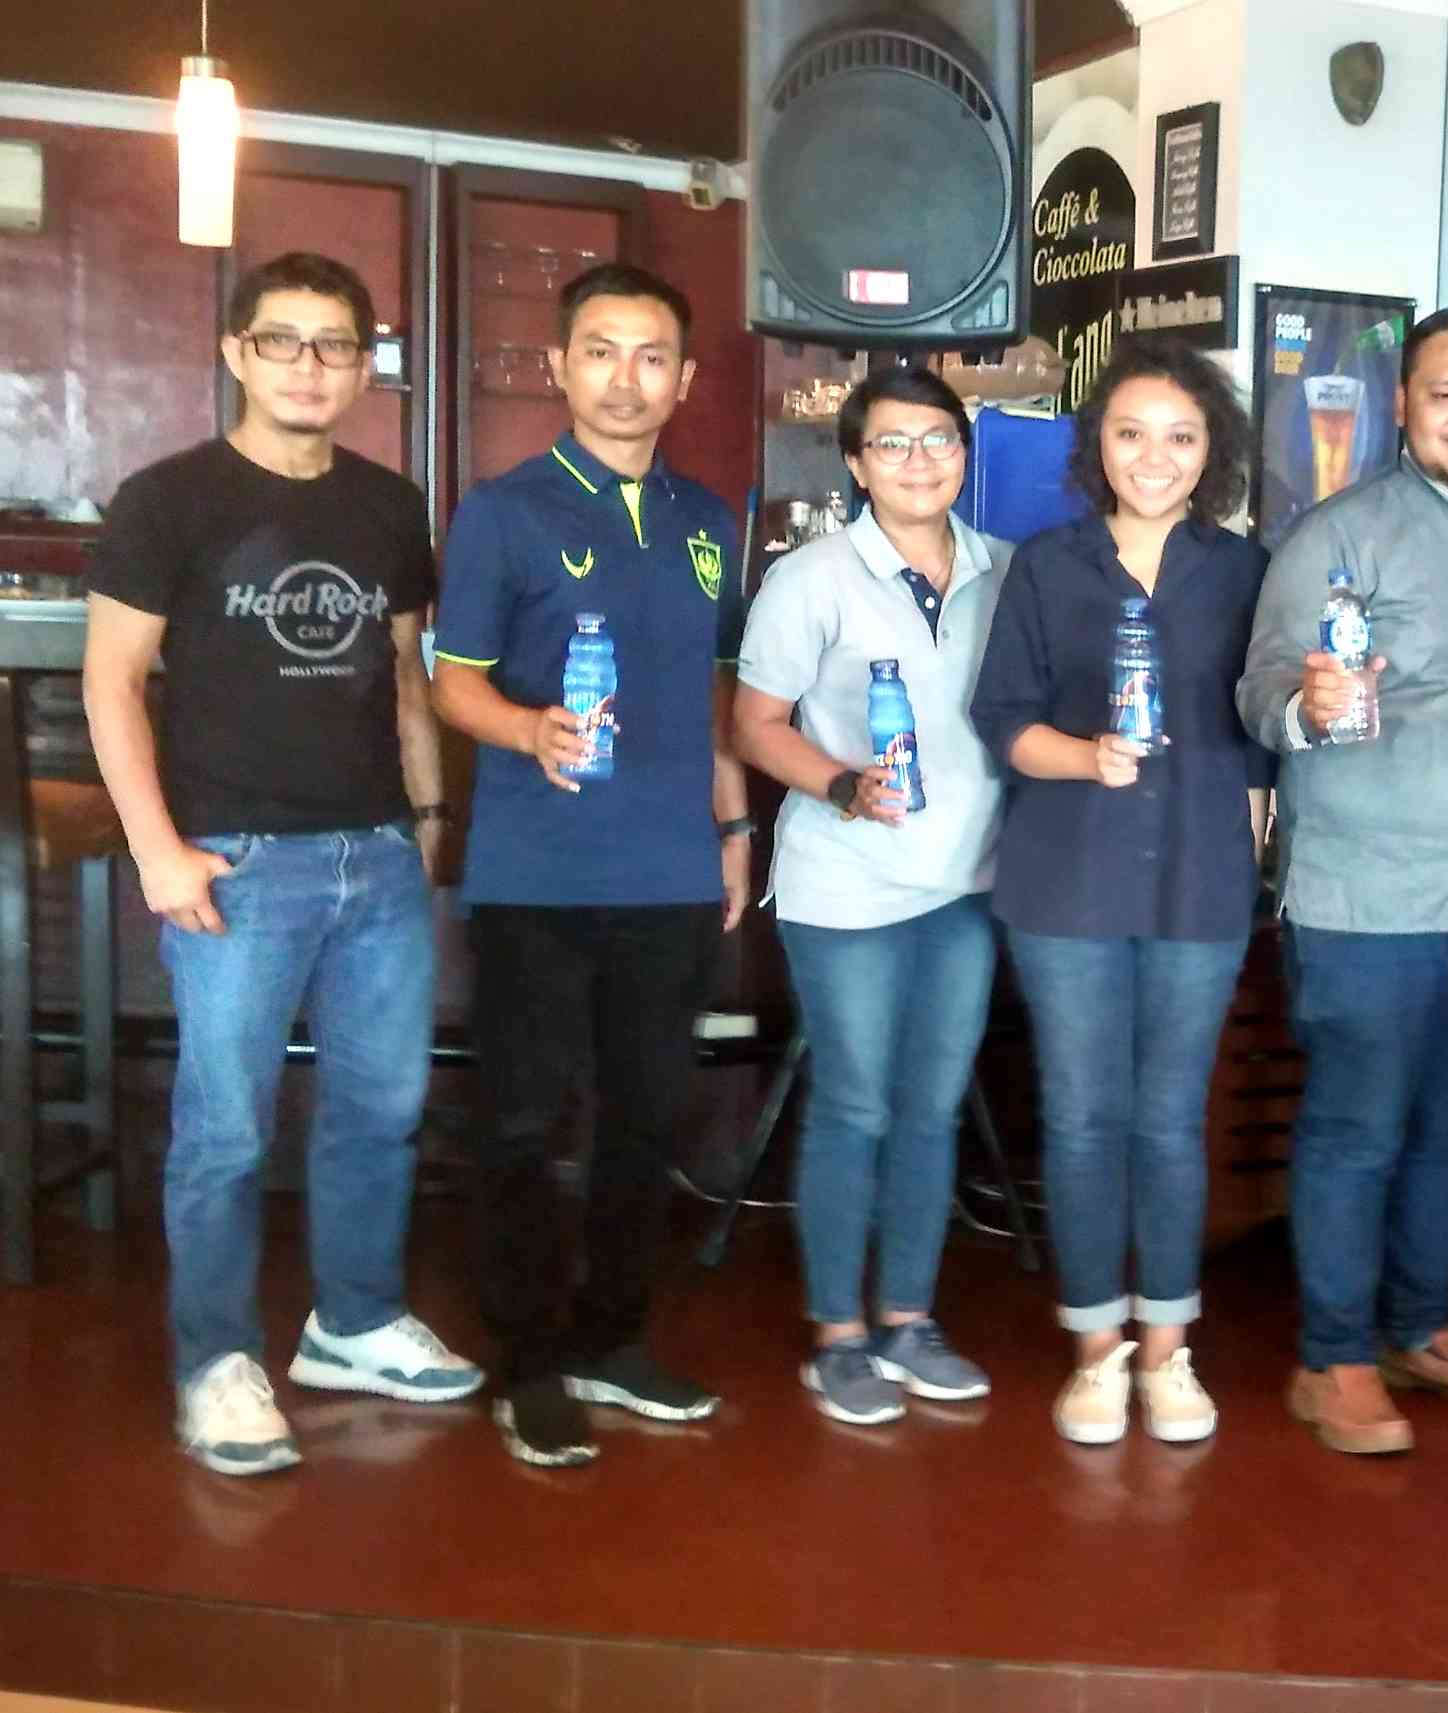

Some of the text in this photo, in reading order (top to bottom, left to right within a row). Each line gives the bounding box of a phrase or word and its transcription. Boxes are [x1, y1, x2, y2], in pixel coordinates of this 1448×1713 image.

[1034, 187, 1100, 241] Caffé &
[1033, 236, 1127, 287] Cioccolata
[1275, 313, 1305, 328] GOOD
[225, 581, 389, 623] Hard Rock
